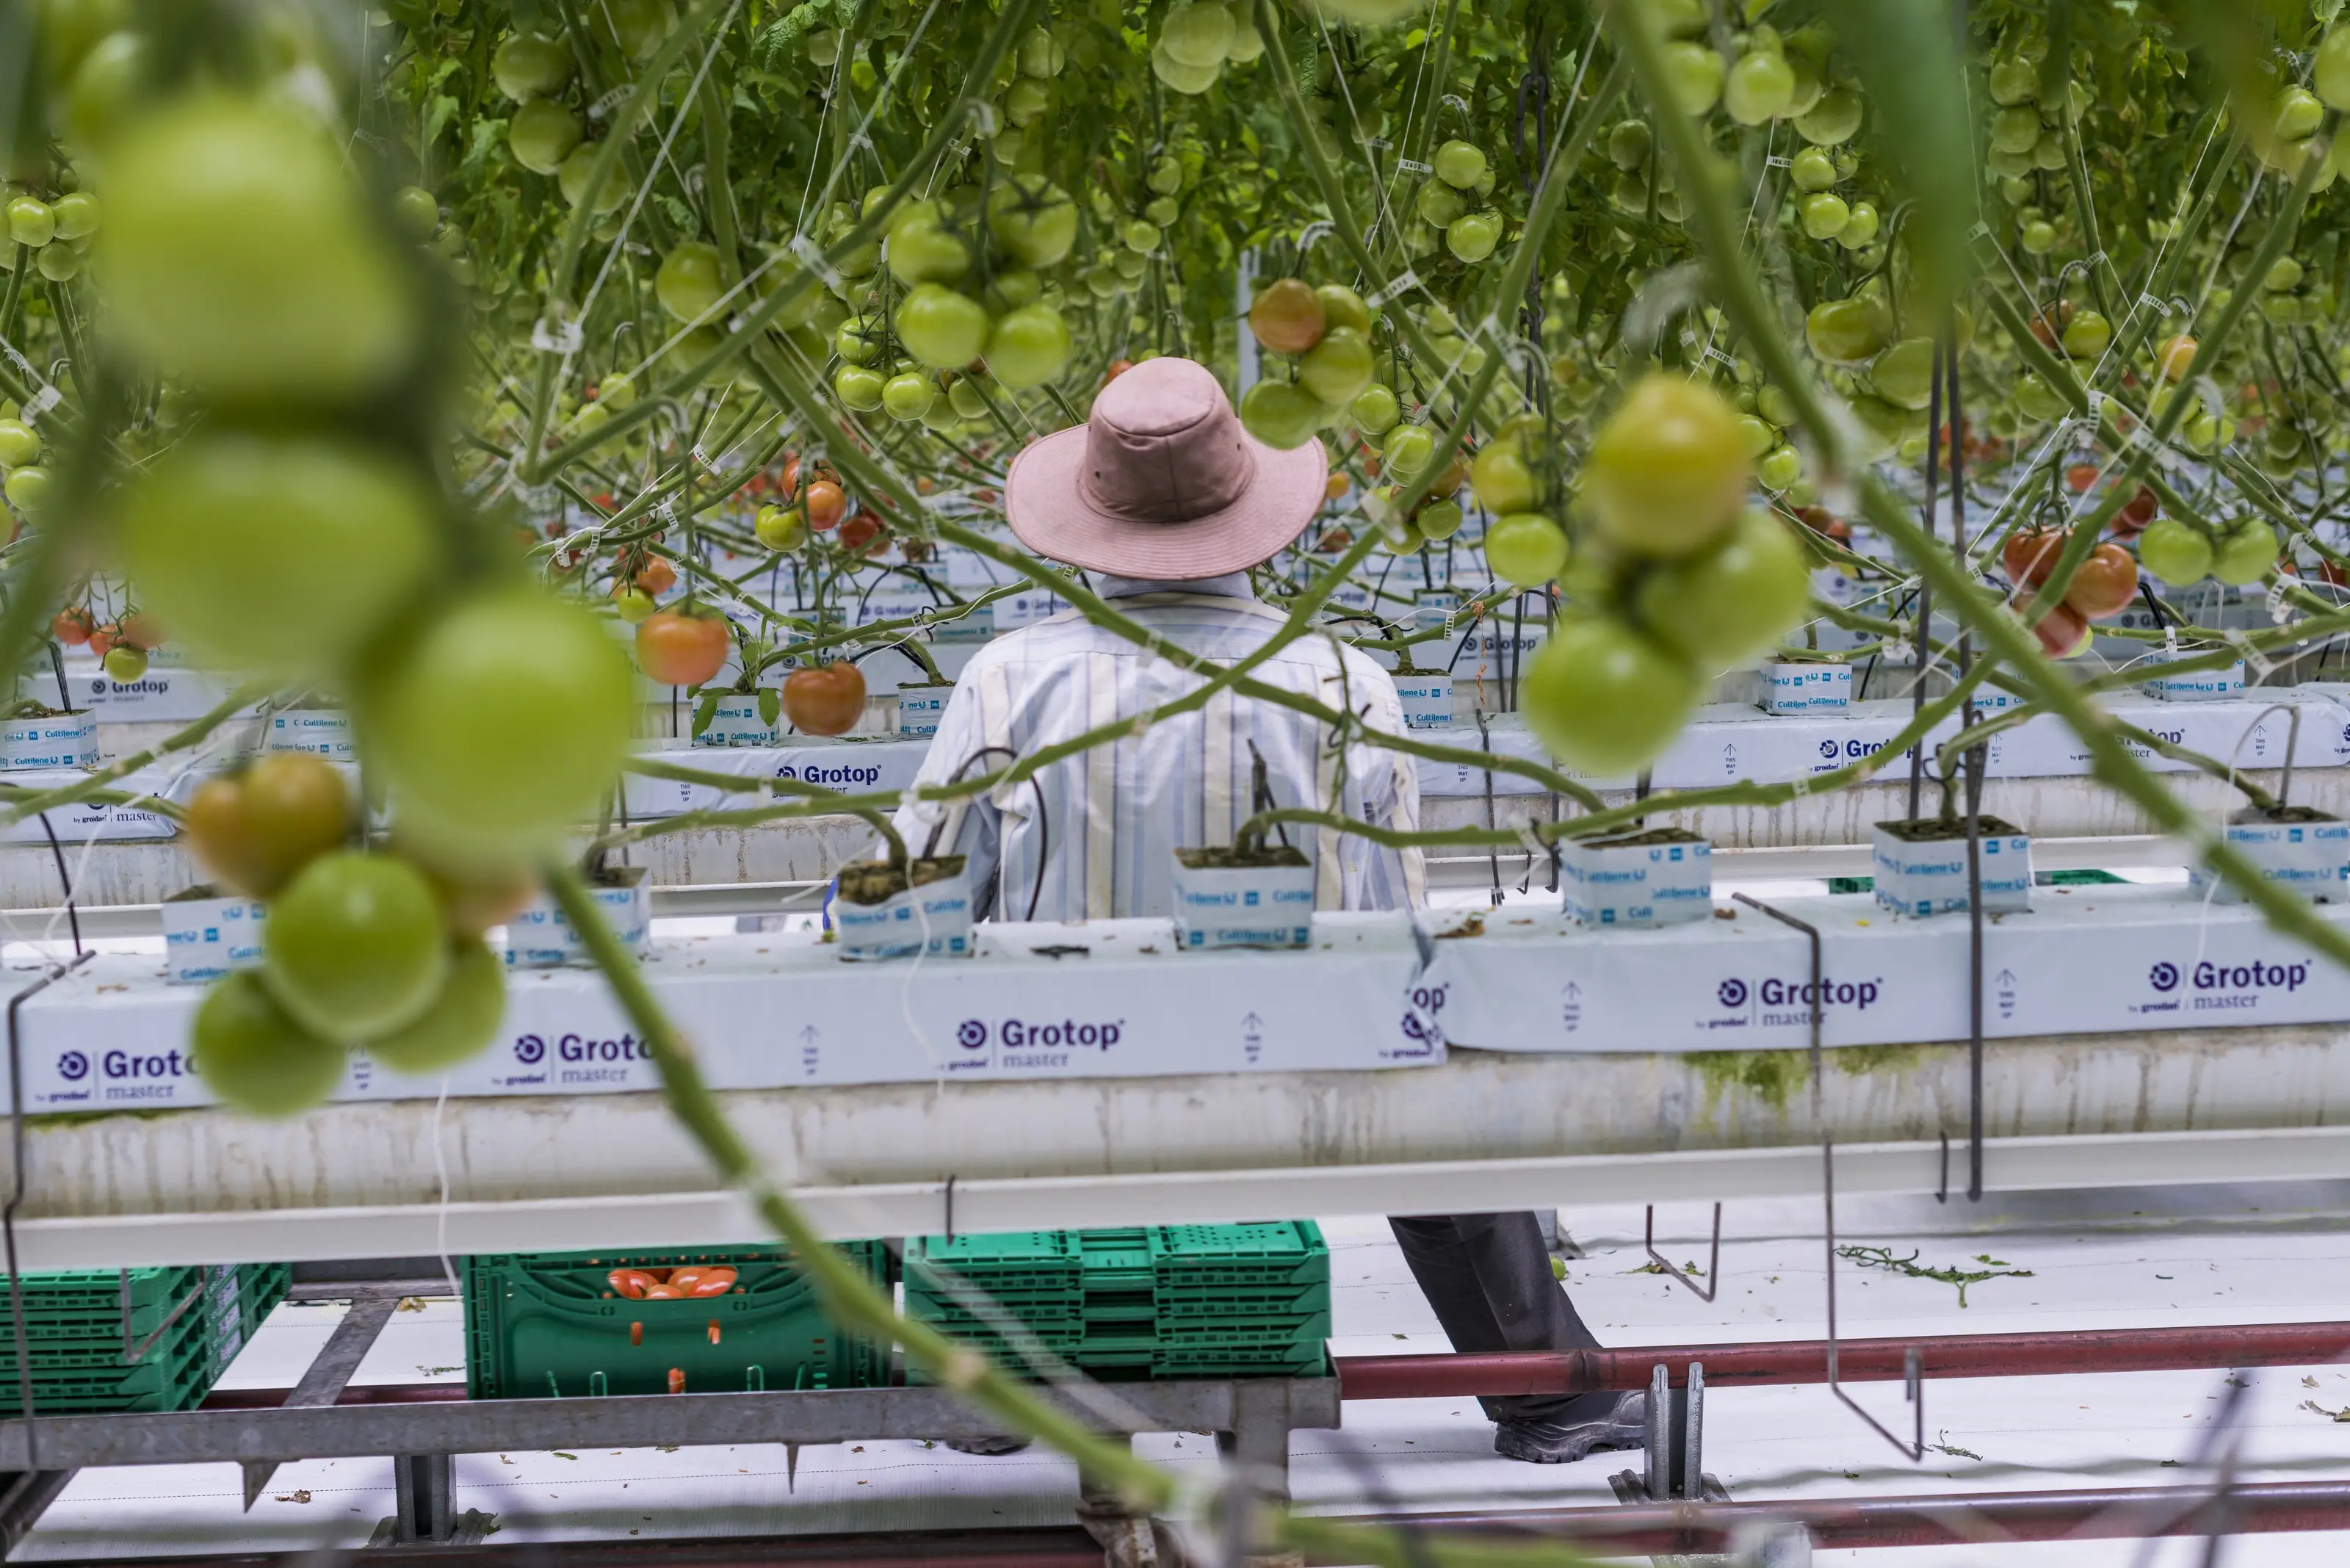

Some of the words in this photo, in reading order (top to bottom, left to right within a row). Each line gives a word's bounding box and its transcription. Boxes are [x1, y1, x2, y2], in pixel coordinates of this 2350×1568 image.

[303, 719, 337, 727] Cultilene
[1416, 714, 1448, 722] Cultilene
[45, 729, 80, 738] Cultilene
[15, 757, 48, 766] Cultilene
[804, 765, 878, 786] Grotop
[117, 813, 157, 822] master
[2194, 959, 2307, 992] Grotop
[2194, 994, 2258, 1010] master
[1001, 1019, 1119, 1052] Grotop
[1002, 1052, 1069, 1068] master
[561, 1069, 628, 1085] master
[106, 1085, 174, 1101] master
